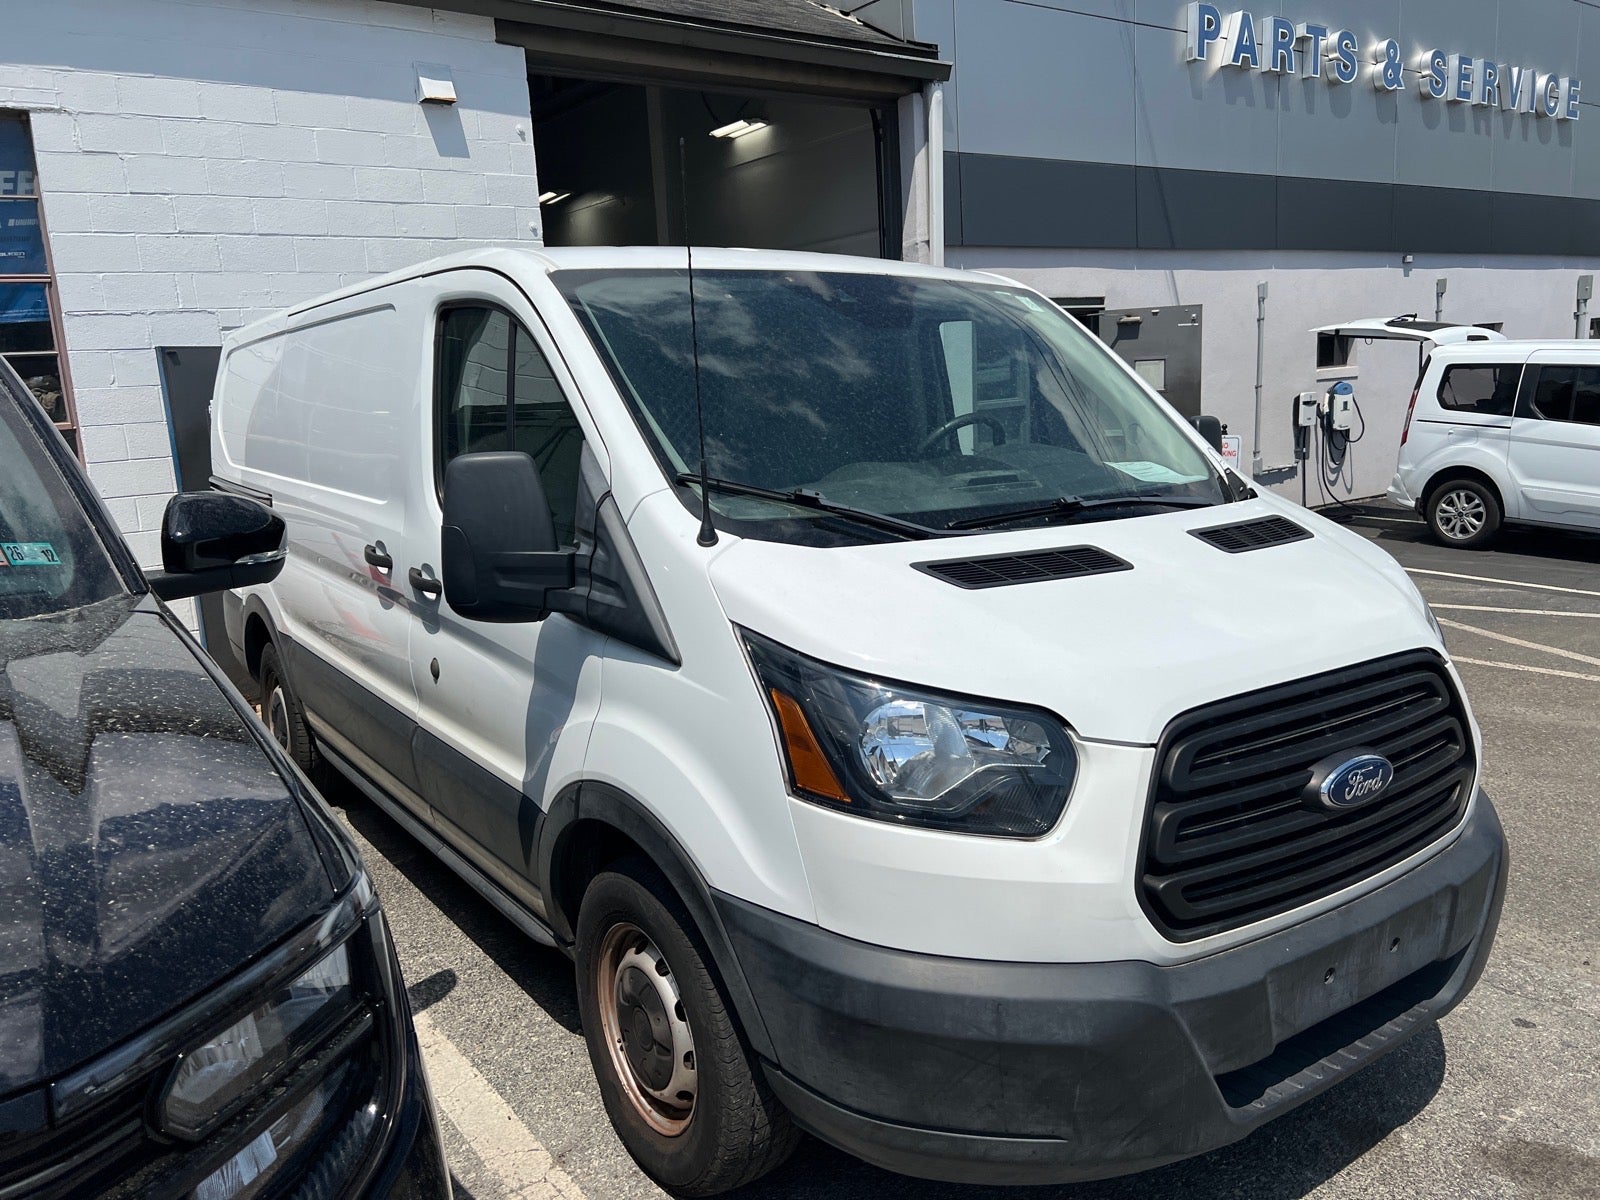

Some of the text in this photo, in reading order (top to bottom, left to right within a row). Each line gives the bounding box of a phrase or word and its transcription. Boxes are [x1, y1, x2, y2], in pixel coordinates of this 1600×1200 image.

[1189, 2, 1582, 120] PARTS & SERVICE
[6, 546, 24, 561] 26
[1344, 766, 1383, 800] Ford
